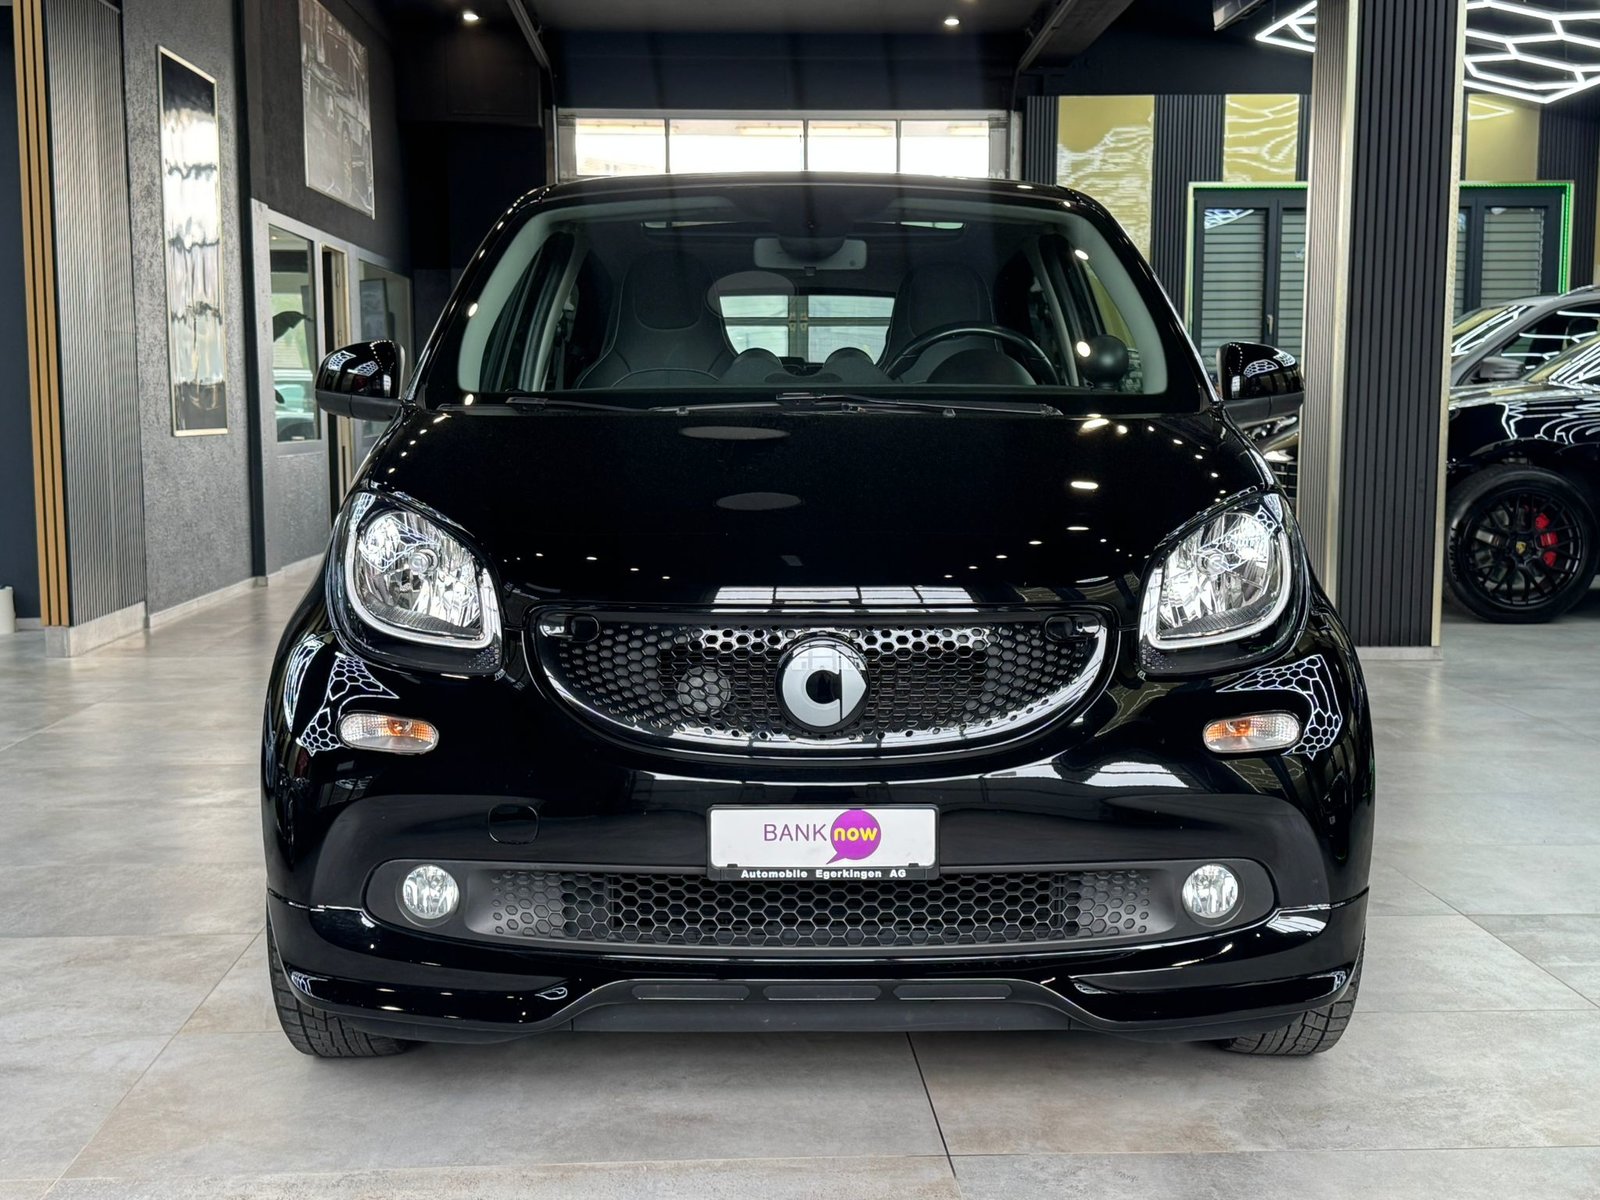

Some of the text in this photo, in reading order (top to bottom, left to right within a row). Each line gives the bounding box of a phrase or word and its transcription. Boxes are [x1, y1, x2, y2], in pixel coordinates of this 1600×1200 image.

[764, 824, 878, 842] BANK now
[741, 869, 907, 880] Automobile Egerkingen AG
